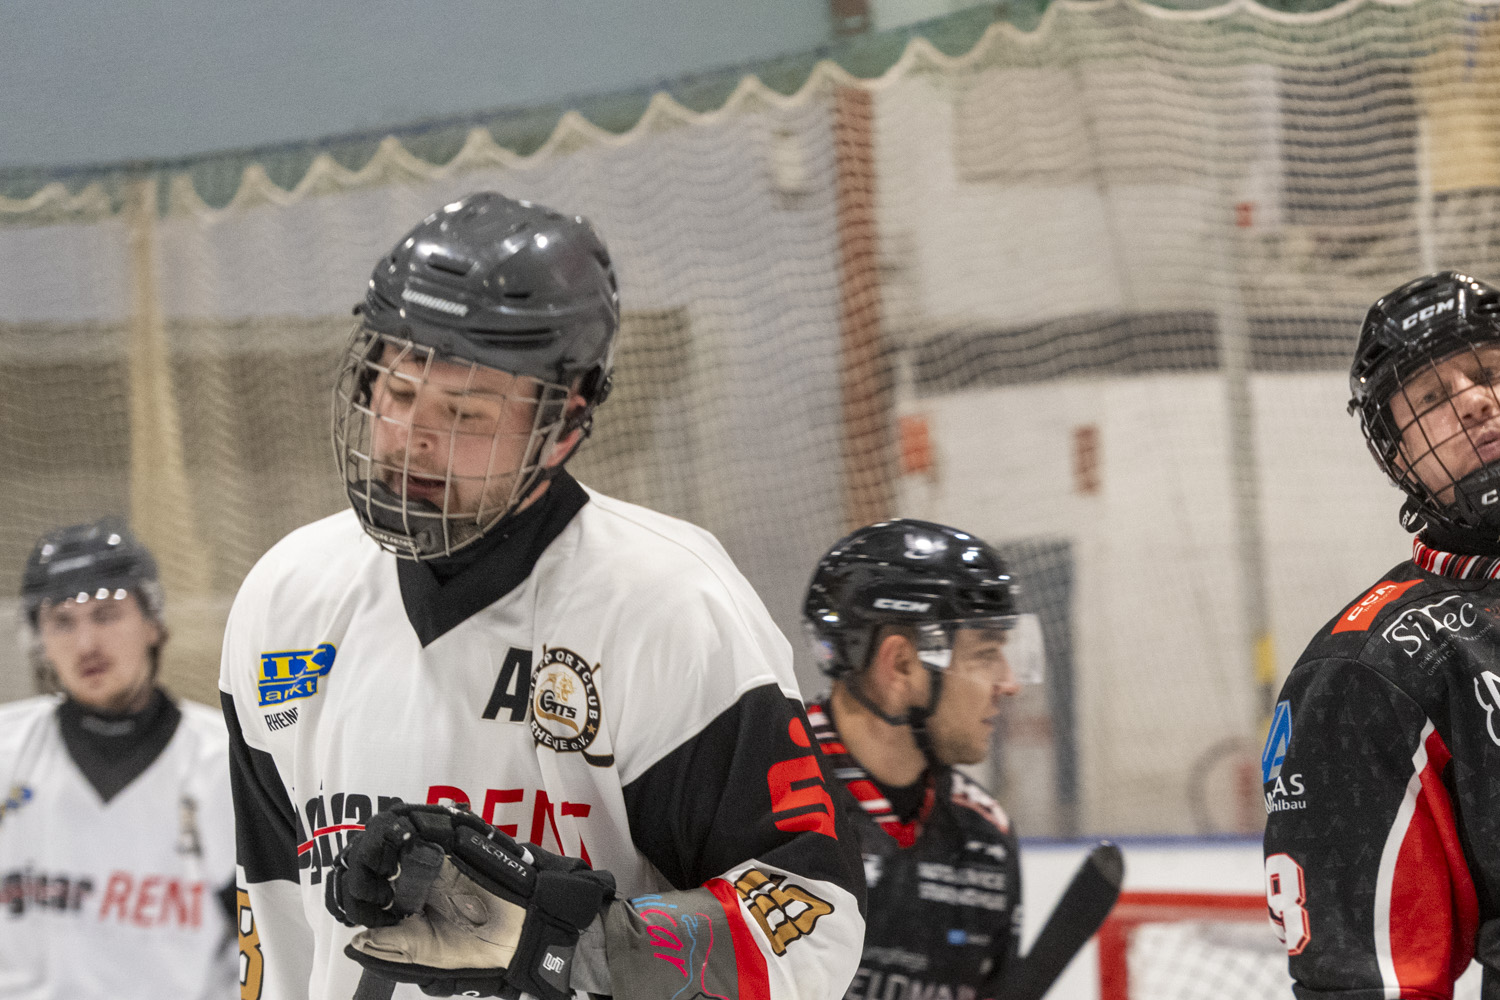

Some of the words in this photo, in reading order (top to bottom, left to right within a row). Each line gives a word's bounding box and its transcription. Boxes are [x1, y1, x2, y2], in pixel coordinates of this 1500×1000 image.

[1402, 298, 1455, 331] CCM
[481, 646, 533, 722] A
[98, 869, 207, 932] RENT
